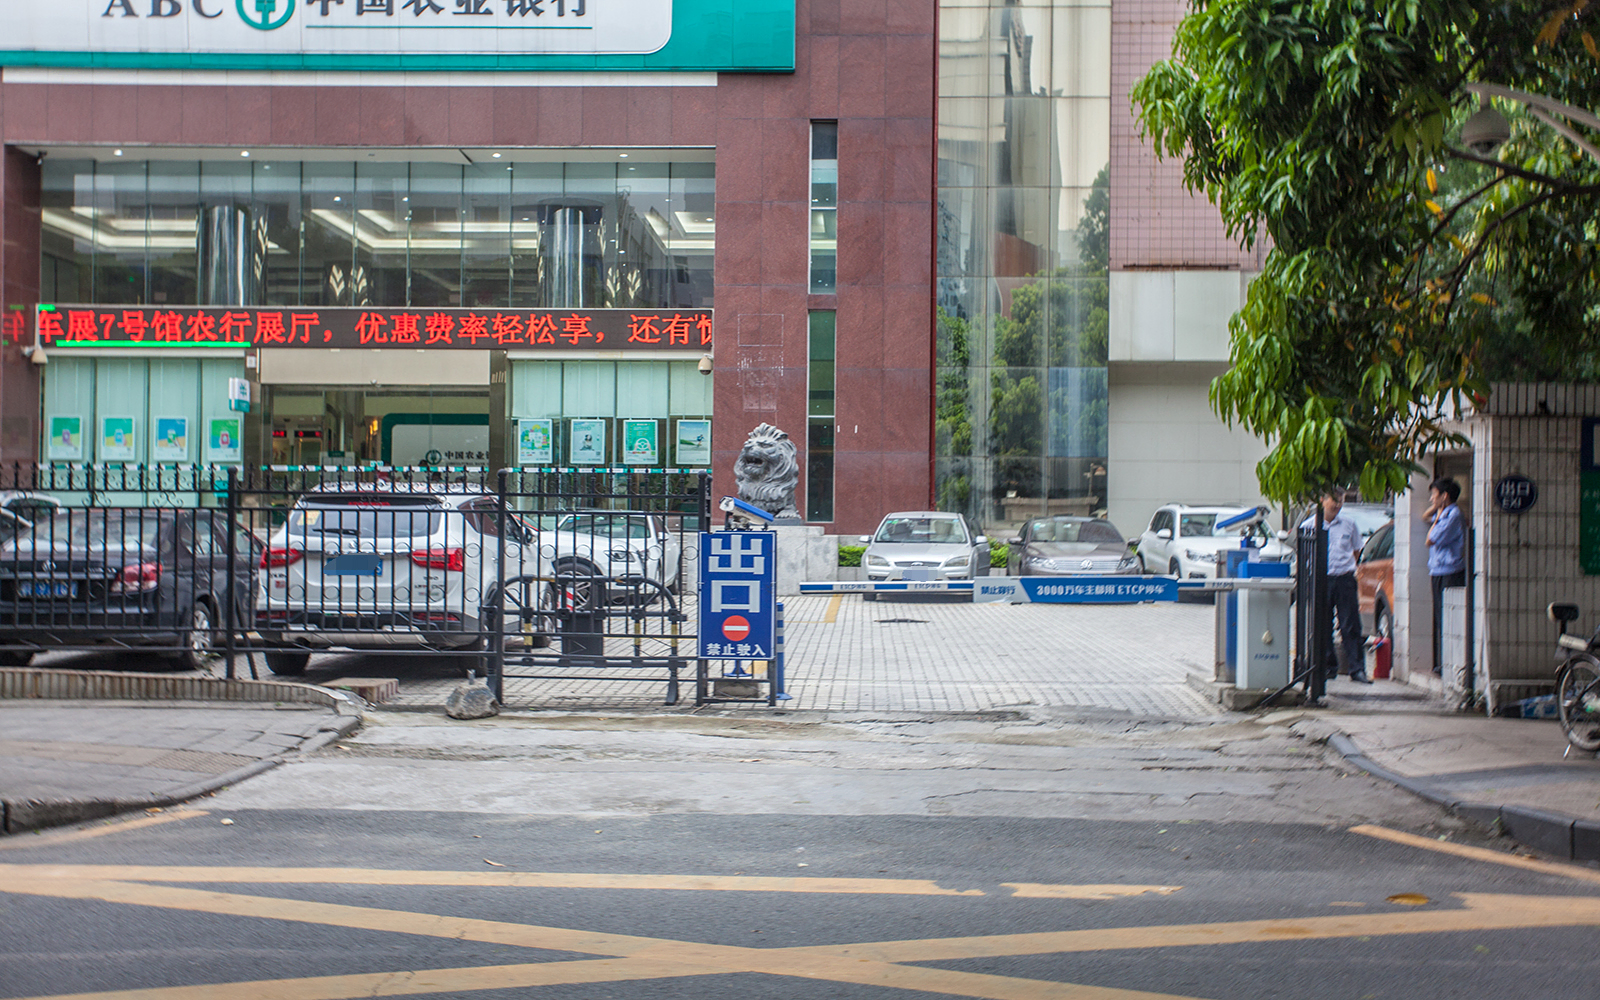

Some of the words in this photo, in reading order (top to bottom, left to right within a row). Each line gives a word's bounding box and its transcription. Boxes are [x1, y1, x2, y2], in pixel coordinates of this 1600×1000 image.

[1501, 480, 1530, 497] 出口
[708, 534, 765, 613] 出口
[706, 643, 766, 656] 禁止驶入
